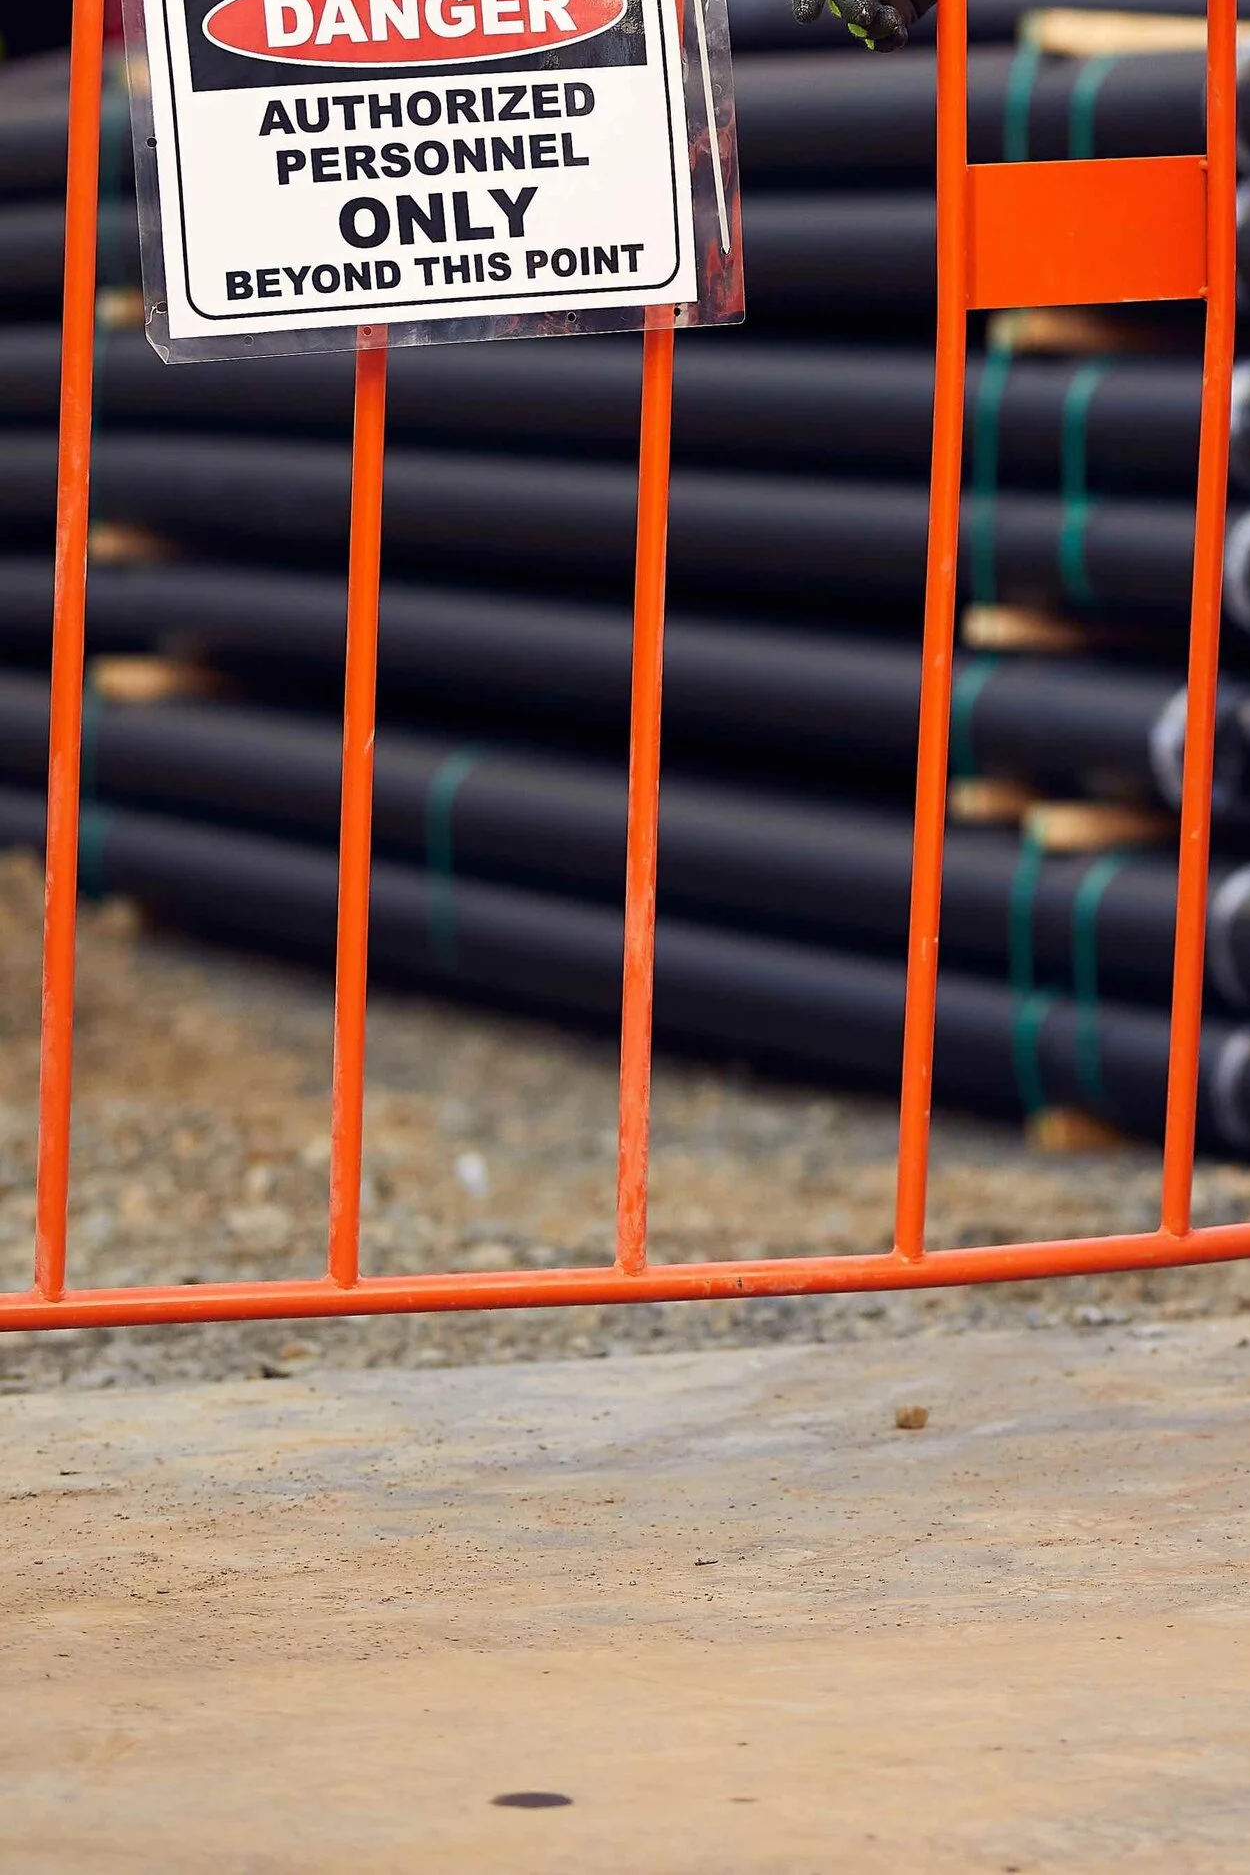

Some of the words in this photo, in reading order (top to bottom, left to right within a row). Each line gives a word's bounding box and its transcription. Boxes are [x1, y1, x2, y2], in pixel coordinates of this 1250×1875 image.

[259, 82, 595, 136] AUTHORIZED
[276, 132, 590, 185] PERSONNEL
[338, 186, 538, 249] ONLY
[226, 260, 401, 301] BEYOND
[415, 252, 512, 286] THIS
[525, 244, 644, 279] POINT
